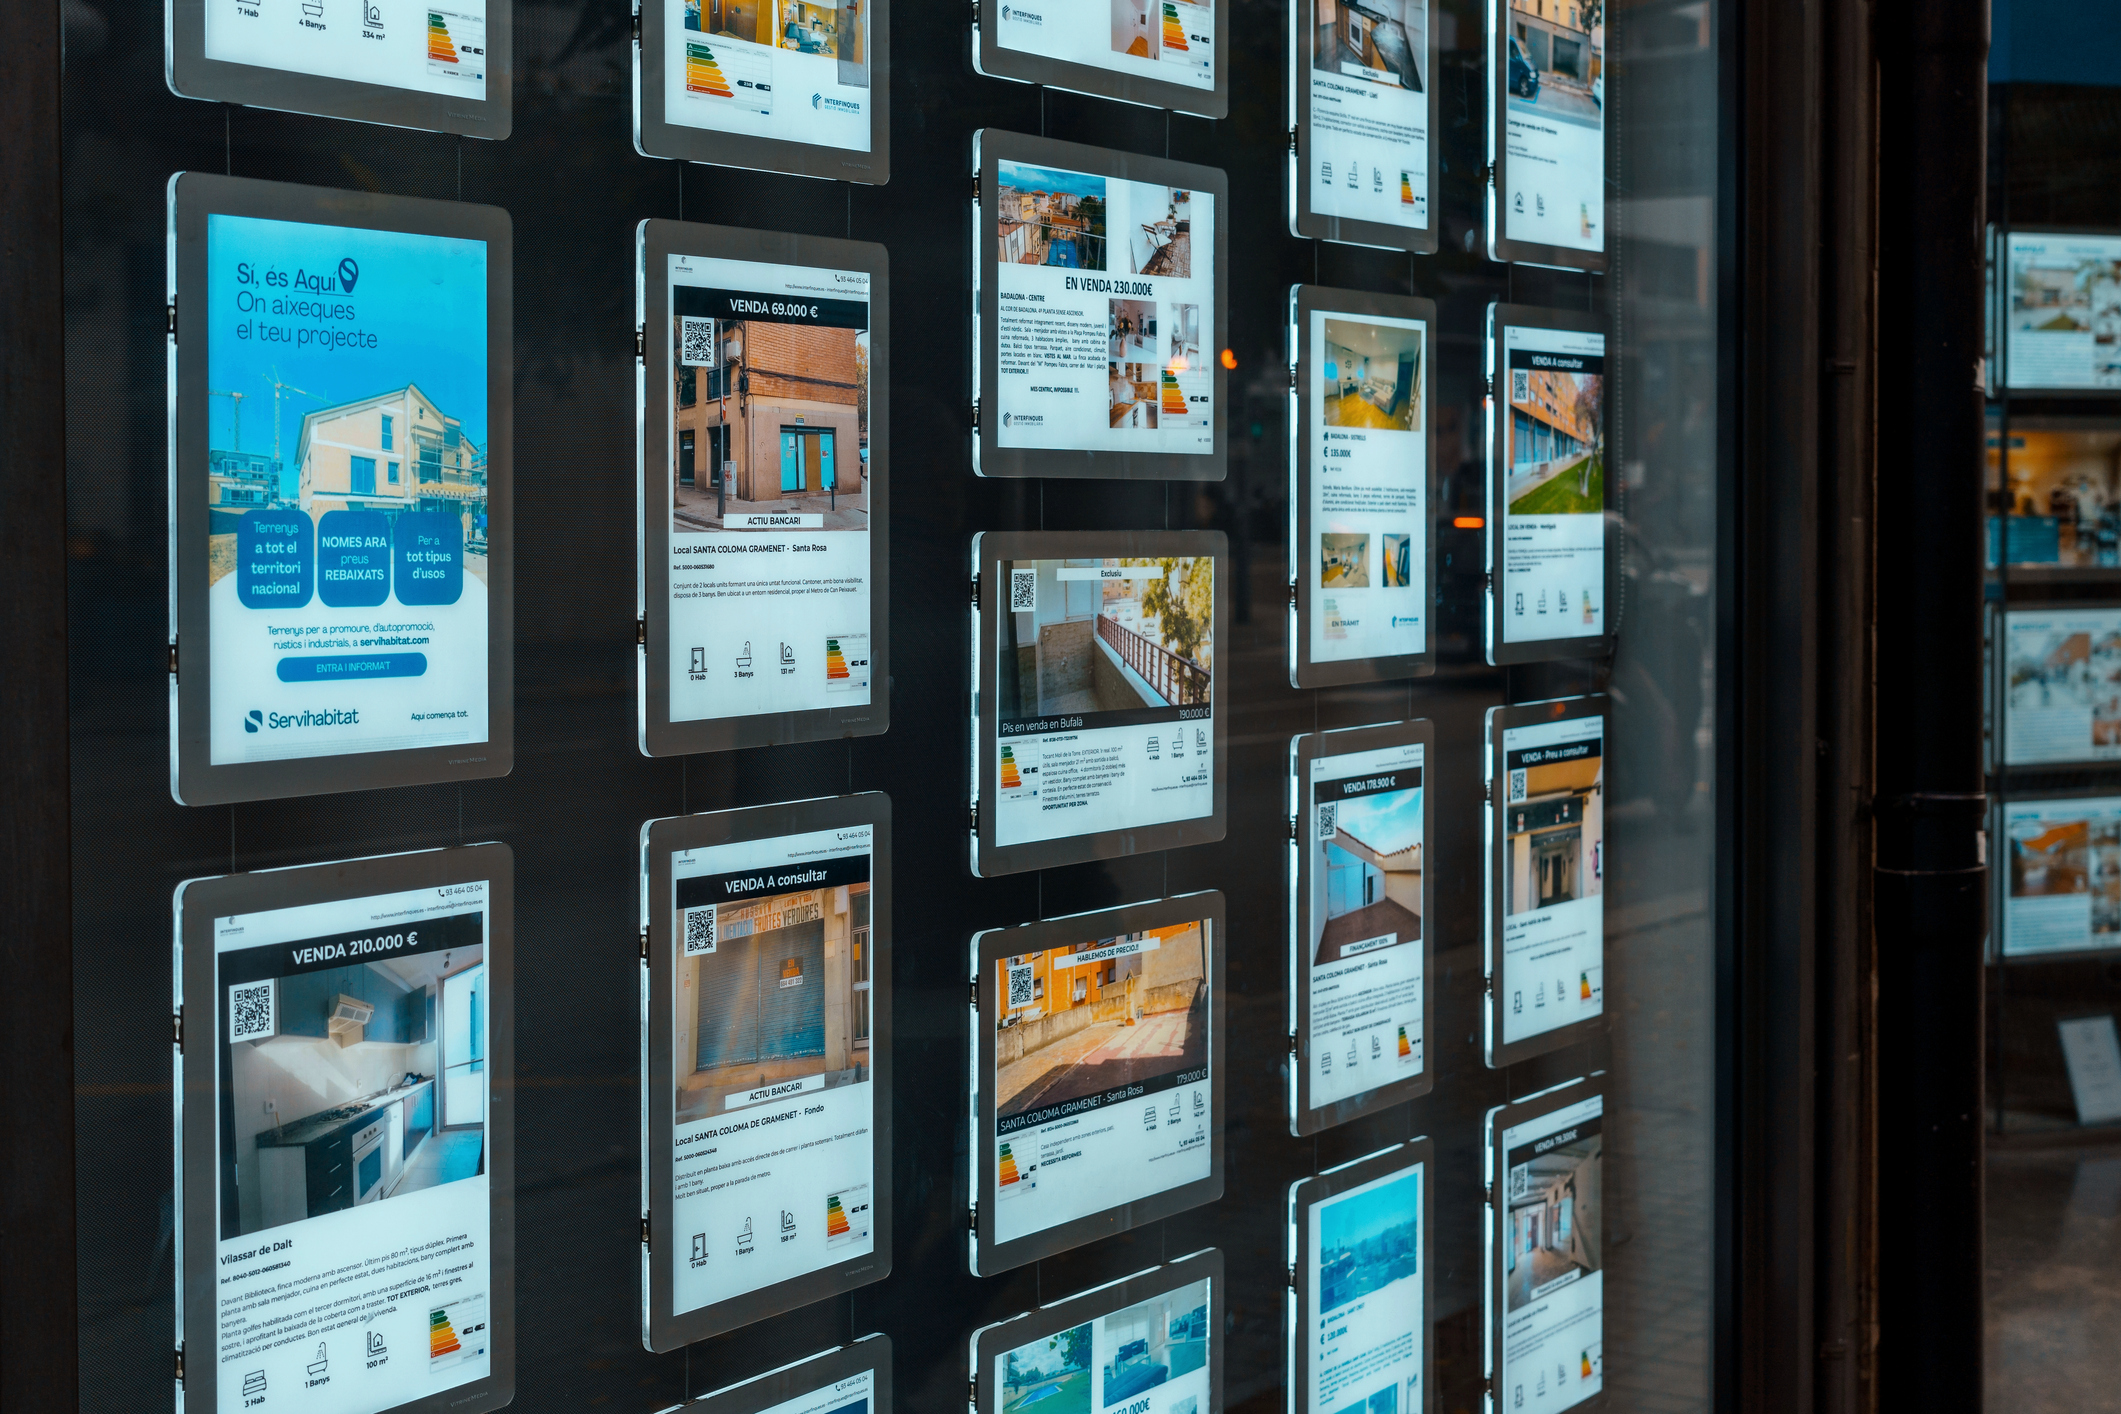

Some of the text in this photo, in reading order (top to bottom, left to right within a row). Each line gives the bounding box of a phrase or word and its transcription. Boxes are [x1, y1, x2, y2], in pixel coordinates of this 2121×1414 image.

[238, 7, 259, 18] 7 Hab
[299, 19, 326, 31] 4 Banys
[362, 30, 386, 41] 334 m²
[1362, 69, 1379, 78] Exclusiu
[824, 98, 860, 110] INTERFINQUES
[237, 262, 336, 295] Sí, és Aquí
[1066, 276, 1152, 296] EN VENDA 230.000€
[1000, 292, 1026, 301] BADALONA
[237, 291, 356, 323] On aixeques
[730, 298, 818, 318] VENDA 69.000 €
[237, 319, 378, 351] el teu projecte
[1532, 355, 1551, 366] VENDA
[1558, 358, 1584, 369] consultar
[748, 516, 800, 526] ACTIU BANCARI
[254, 521, 299, 536] Terrenys
[255, 541, 297, 554] a tot el
[322, 536, 387, 548] NOMES ARA
[418, 535, 432, 546] Per
[674, 544, 828, 554] Local SANTA COLOMA GRAMENET Santa Rosa
[340, 554, 369, 568] preus
[406, 551, 452, 564] tot tipus
[252, 561, 301, 574] territori
[412, 567, 446, 580] d'usos
[325, 569, 384, 581] REBAIXATS
[252, 581, 300, 595] nacional
[268, 626, 304, 637] Terrenys
[306, 626, 320, 636] per
[330, 624, 371, 636] promoure,
[373, 620, 436, 634] d'autopromoció,
[1340, 618, 1360, 626] TRÀMIT
[274, 638, 302, 650] rústics
[308, 638, 351, 650] industrials,
[360, 636, 430, 647] servihabitat.com
[316, 662, 343, 674] ENTRA
[268, 708, 360, 730] Servihabitat
[411, 710, 468, 722] Aquí comença tot.
[1179, 708, 1210, 720] 190.000 €
[1002, 718, 1082, 734] Pis en venda en Bufalà
[1522, 752, 1542, 764] VENDA
[1564, 745, 1589, 758] consultar
[1344, 776, 1396, 794] VENDA 178.900 €
[726, 869, 828, 894] VENDA A consultar
[445, 884, 483, 897] 93 464 05 04
[292, 932, 418, 964] VENDA 210.000 €
[1350, 940, 1378, 952] FINANÇAMENT
[1077, 950, 1106, 962] HABLEMOS
[1108, 948, 1116, 957] DE
[788, 958, 794, 968] EN
[782, 966, 800, 978] VENDA
[1313, 958, 1388, 983] SANTA COLOMA GRAMENET Santa Rosa
[1176, 1068, 1208, 1085] 179.000 €
[749, 1082, 802, 1102] ACTIU BANCARI
[1000, 1086, 1144, 1132] SANTA COLOMA GRAMENET Santa Rosa
[675, 1104, 824, 1146] Local SANTA COLOMA DE GRAMENET Fondo
[1041, 1151, 1082, 1167] NECESSITA REFORMES
[788, 1232, 797, 1241] m²
[220, 1239, 292, 1266] Vilassar de Dalt
[739, 1246, 754, 1256] Banys
[696, 1260, 707, 1268] Hab
[387, 1285, 430, 1303] TOT EXTERIOR,
[366, 1356, 388, 1370] 100 m²
[310, 1376, 330, 1388] Banys
[244, 1394, 266, 1408] 3 Hab
